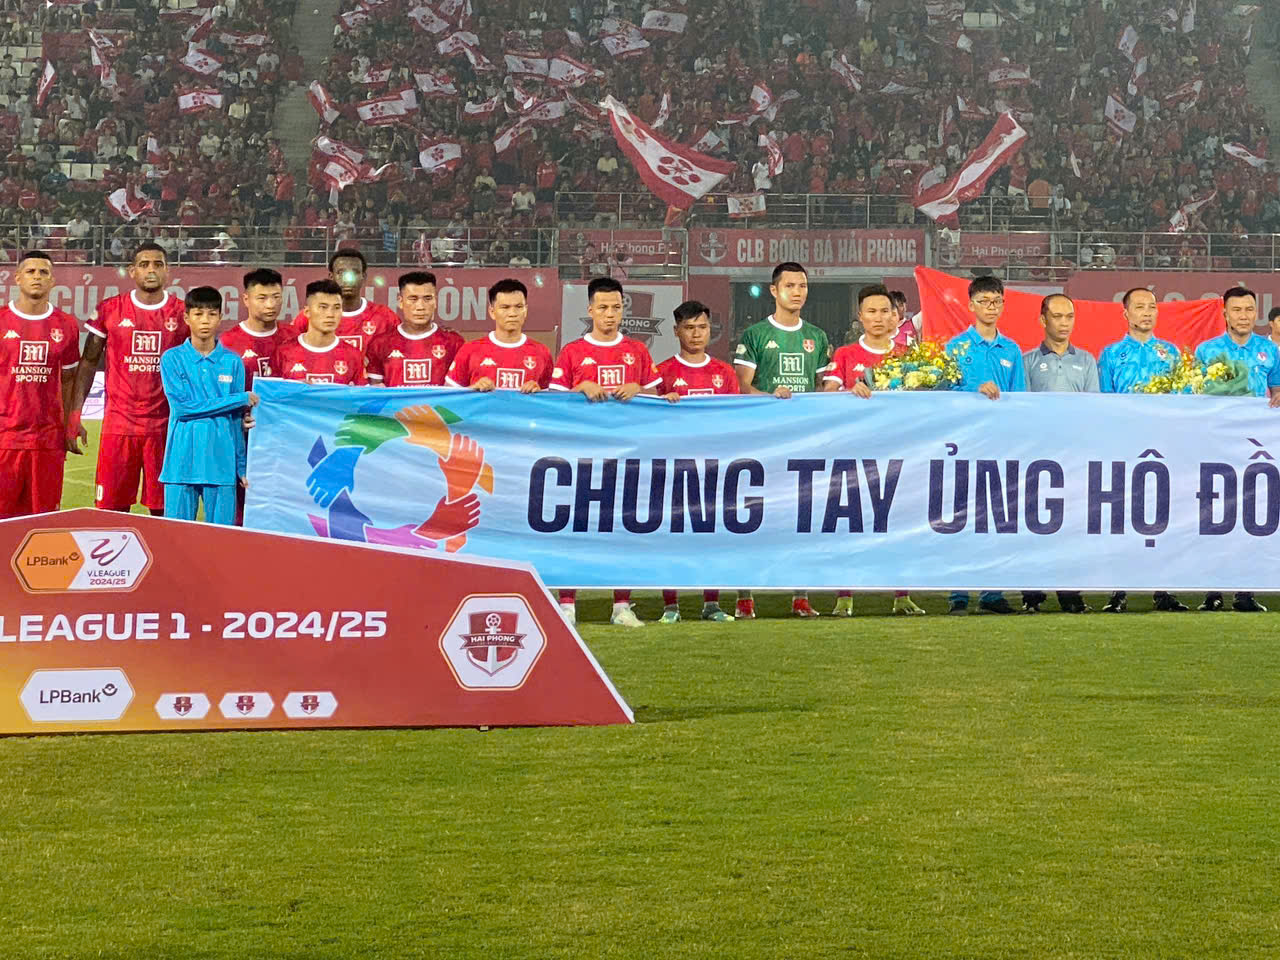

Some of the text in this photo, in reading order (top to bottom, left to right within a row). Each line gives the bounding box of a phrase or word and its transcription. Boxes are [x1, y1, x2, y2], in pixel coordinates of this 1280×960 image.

[737, 231, 916, 263] CLB BÓNG ĐÁ HẢI PHÒNG
[124, 356, 161, 364] MANSIO
[11, 366, 52, 375] MANSION
[128, 364, 161, 372] SPORTS
[15, 375, 47, 383] SPORTS
[773, 377, 810, 385] MANSION
[527, 456, 765, 535] CHUNG
[787, 458, 904, 534] TAY
[927, 442, 1064, 535] ỦNG
[1087, 448, 1171, 548] HỘ
[27, 556, 68, 566] LPBank
[171, 613, 190, 640] 1
[222, 611, 388, 642] 2024/25
[39, 689, 102, 704] LPBank
